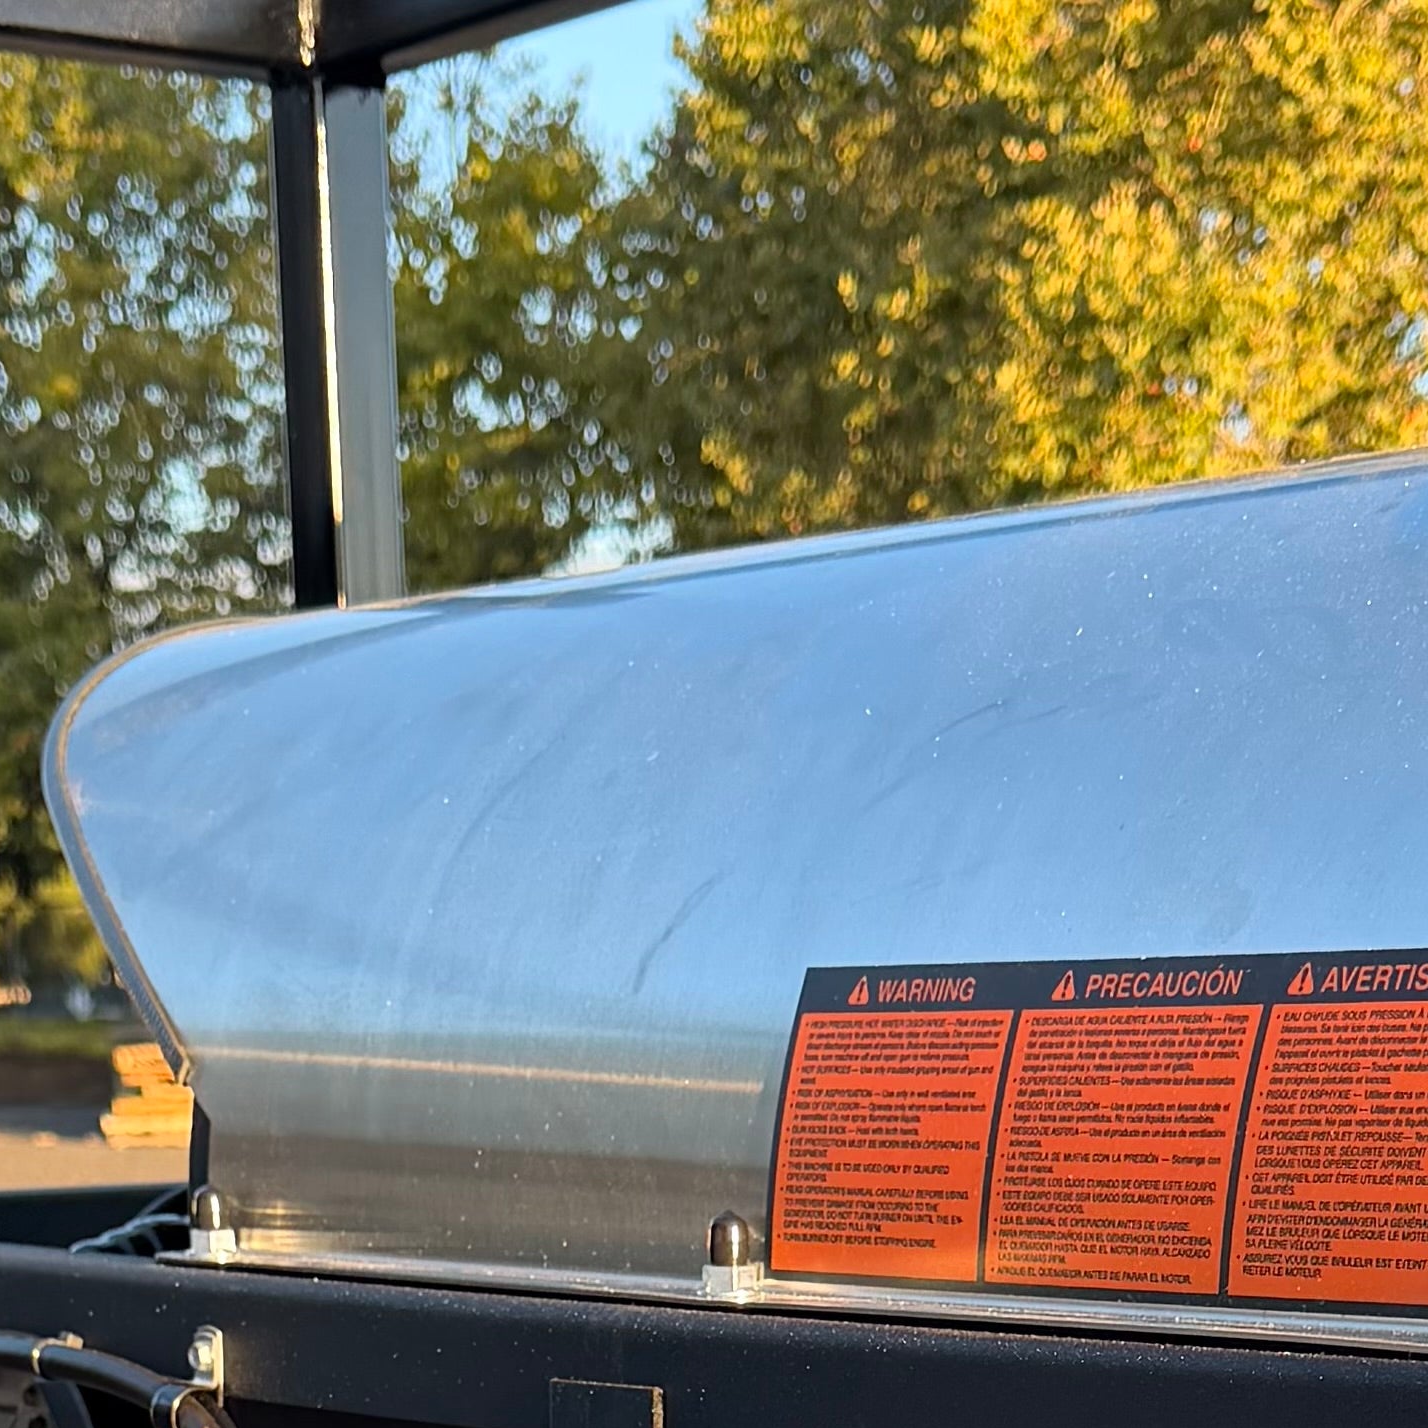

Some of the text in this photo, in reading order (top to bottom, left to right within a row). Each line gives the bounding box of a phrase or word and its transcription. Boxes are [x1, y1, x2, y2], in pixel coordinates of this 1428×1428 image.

[1085, 964, 1243, 998] PRECAUCIÓN
[878, 977, 976, 1003] WARNING
[1342, 1010, 1367, 1020] SOUS
[1266, 1090, 1299, 1099] RISQUE
[1263, 1104, 1297, 1114] RISQUE
[1258, 1130, 1269, 1140] LA
[1256, 1146, 1274, 1156] DES
[1324, 1146, 1336, 1157] DE
[1360, 1159, 1379, 1170] CET
[1252, 1173, 1270, 1182] CET
[1312, 1174, 1333, 1183] DOIT
[1395, 1175, 1414, 1185] PAR
[1249, 1199, 1267, 1209] LIRE
[1269, 1200, 1280, 1210] LE
[1318, 1201, 1331, 1211] DE
[1393, 1202, 1422, 1213] AVANT
[1266, 1227, 1277, 1237] LE
[1321, 1228, 1341, 1239] QUE
[1388, 1230, 1400, 1241] LE
[1310, 1256, 1329, 1266] QUE
[1375, 1258, 1395, 1268] EST
[1273, 1266, 1284, 1277] LE
